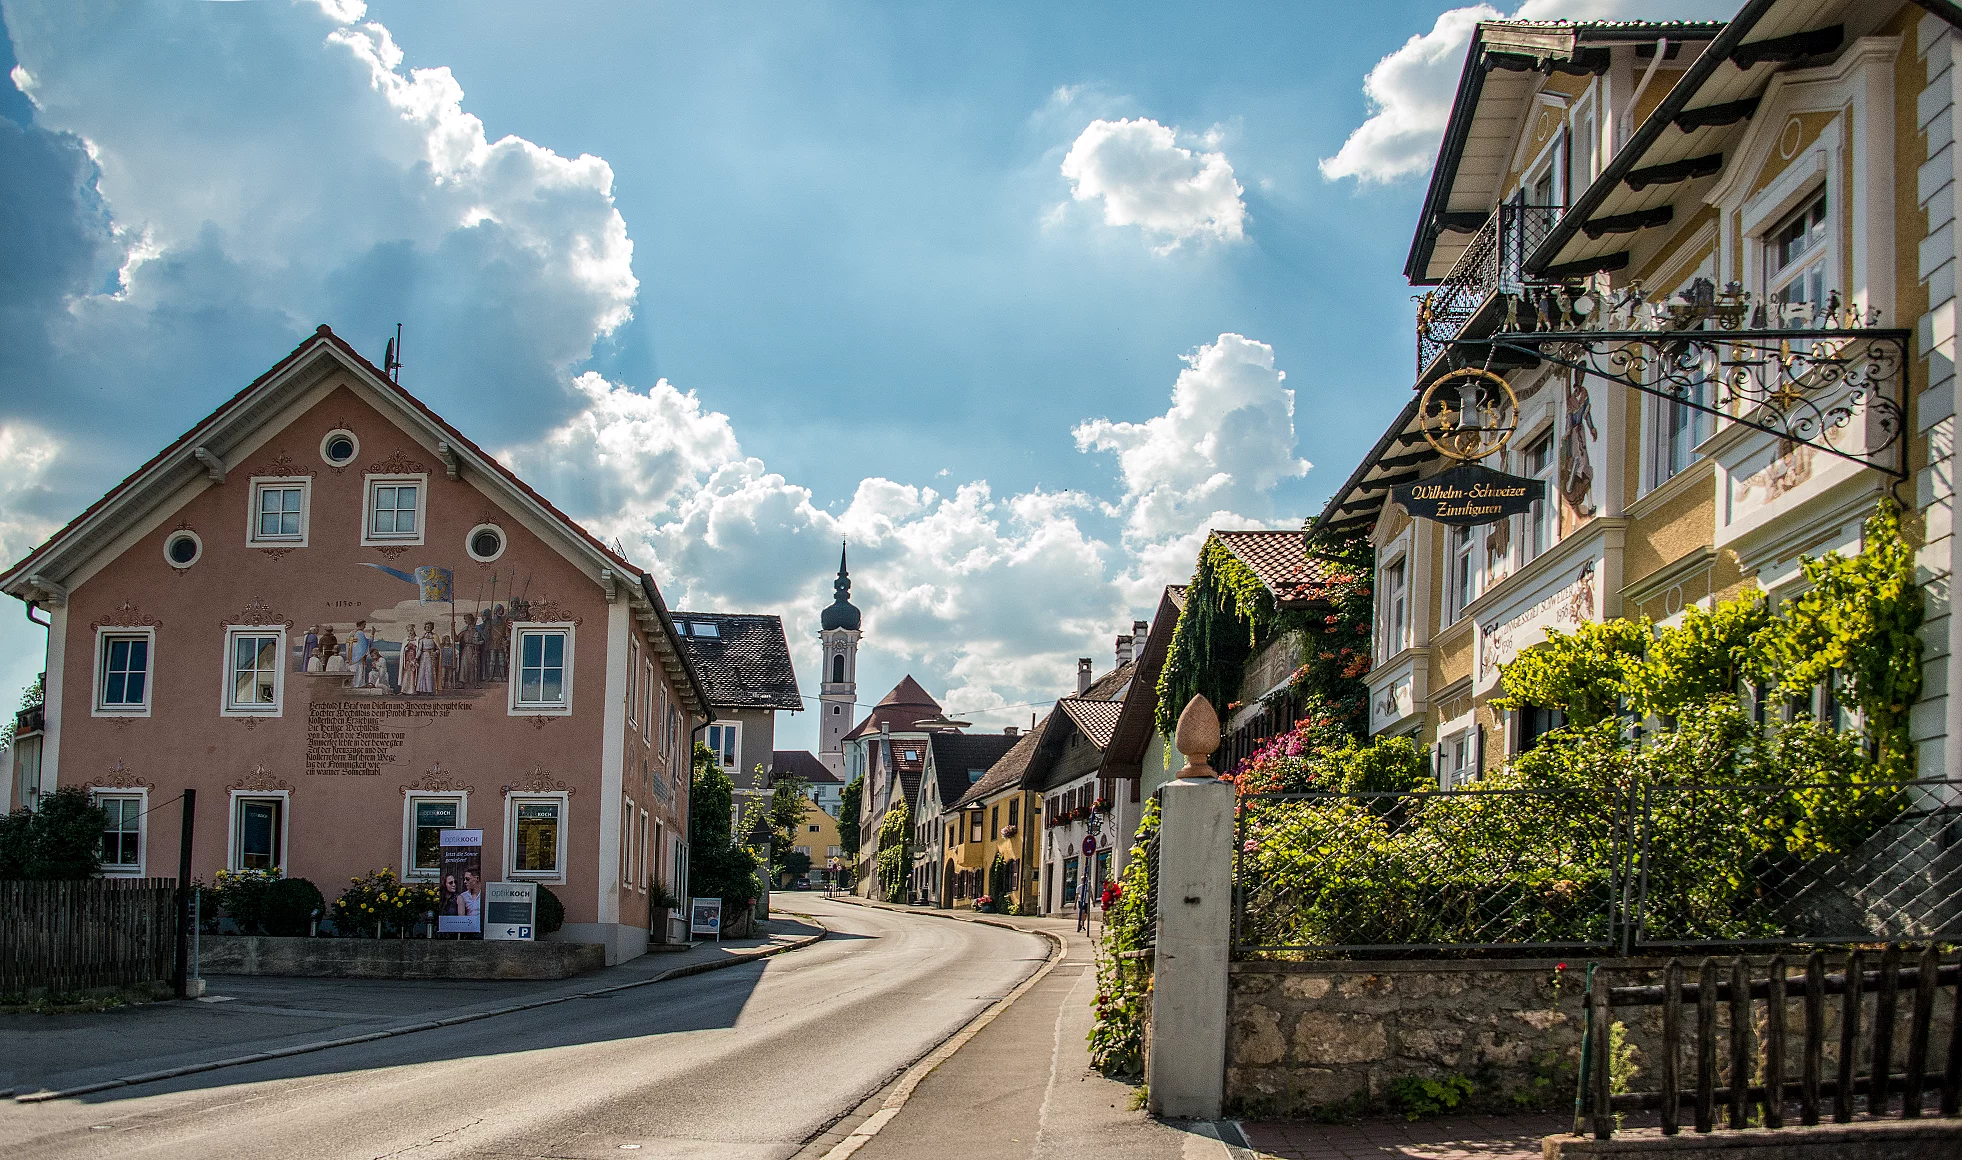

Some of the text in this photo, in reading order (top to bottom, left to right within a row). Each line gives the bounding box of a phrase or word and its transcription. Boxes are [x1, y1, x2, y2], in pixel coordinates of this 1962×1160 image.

[1436, 500, 1502, 517] Zinnfiguren
[405, 701, 432, 710] Andechs
[458, 702, 472, 710] seine
[309, 708, 335, 717] Tochter
[346, 716, 379, 724] Erziehung
[371, 739, 403, 748] bewegten
[307, 746, 320, 754] Zeit
[358, 753, 376, 761] ihrem
[377, 753, 396, 762] Wege
[306, 760, 316, 768] lag
[521, 927, 529, 937] P
